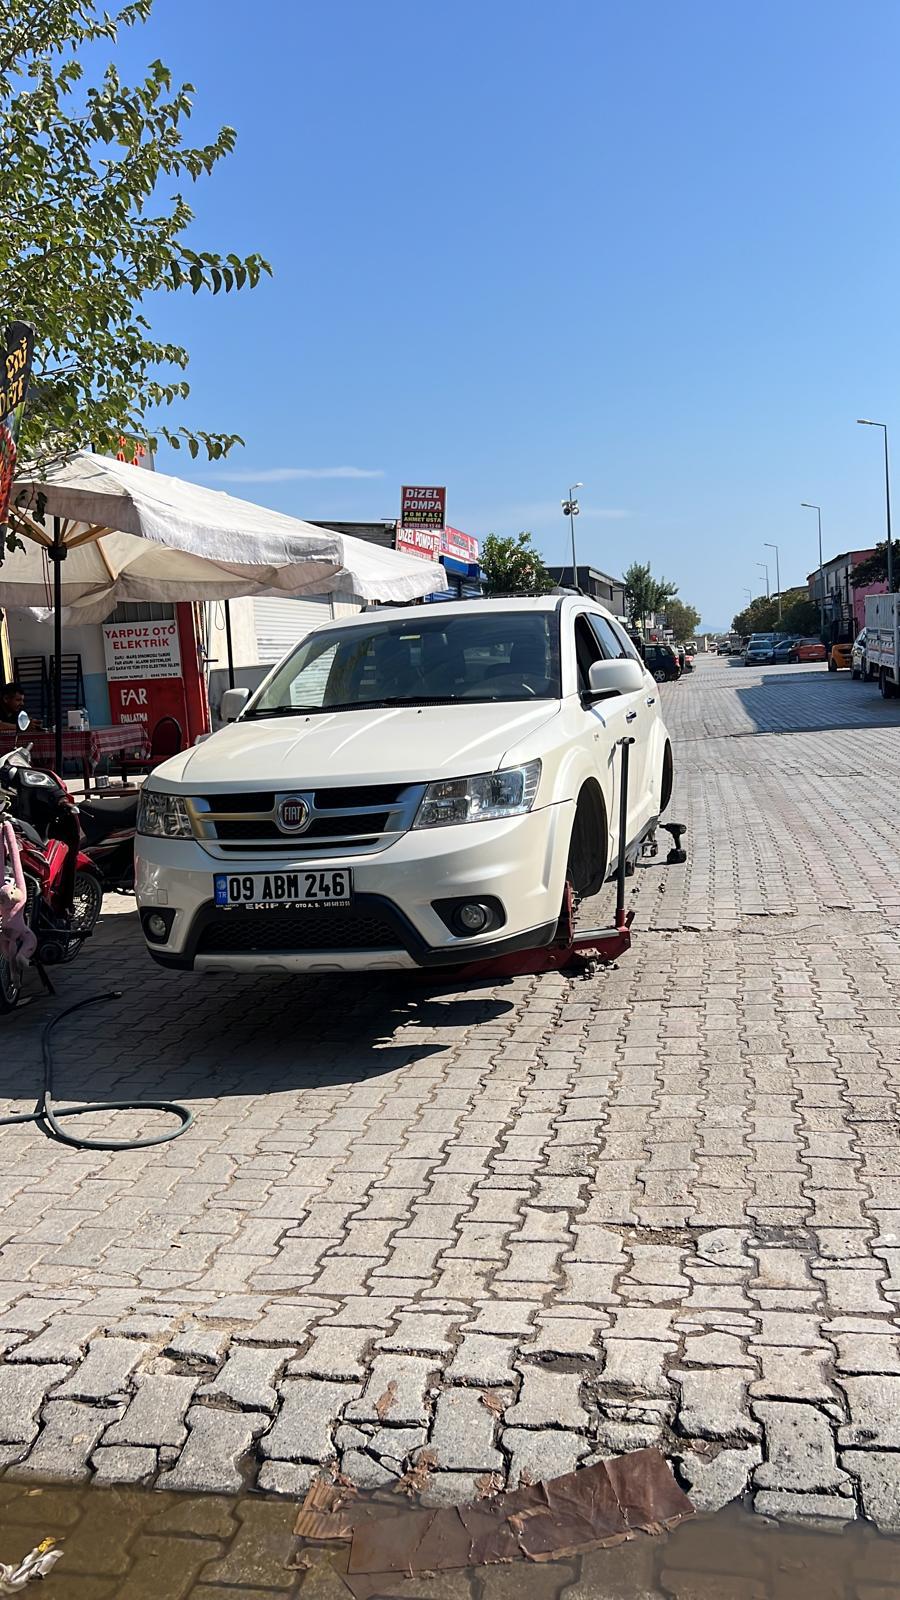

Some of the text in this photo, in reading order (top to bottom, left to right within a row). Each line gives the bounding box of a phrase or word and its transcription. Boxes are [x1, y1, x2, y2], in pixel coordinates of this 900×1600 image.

[404, 500, 442, 510] POMPA
[415, 532, 434, 551] POMPA
[104, 625, 176, 639] YARPUZ OTO
[113, 637, 169, 650] ELEKTRİK
[120, 688, 148, 706] FAR
[284, 806, 302, 821] FIAT
[229, 872, 345, 902] 09 ABM 246
